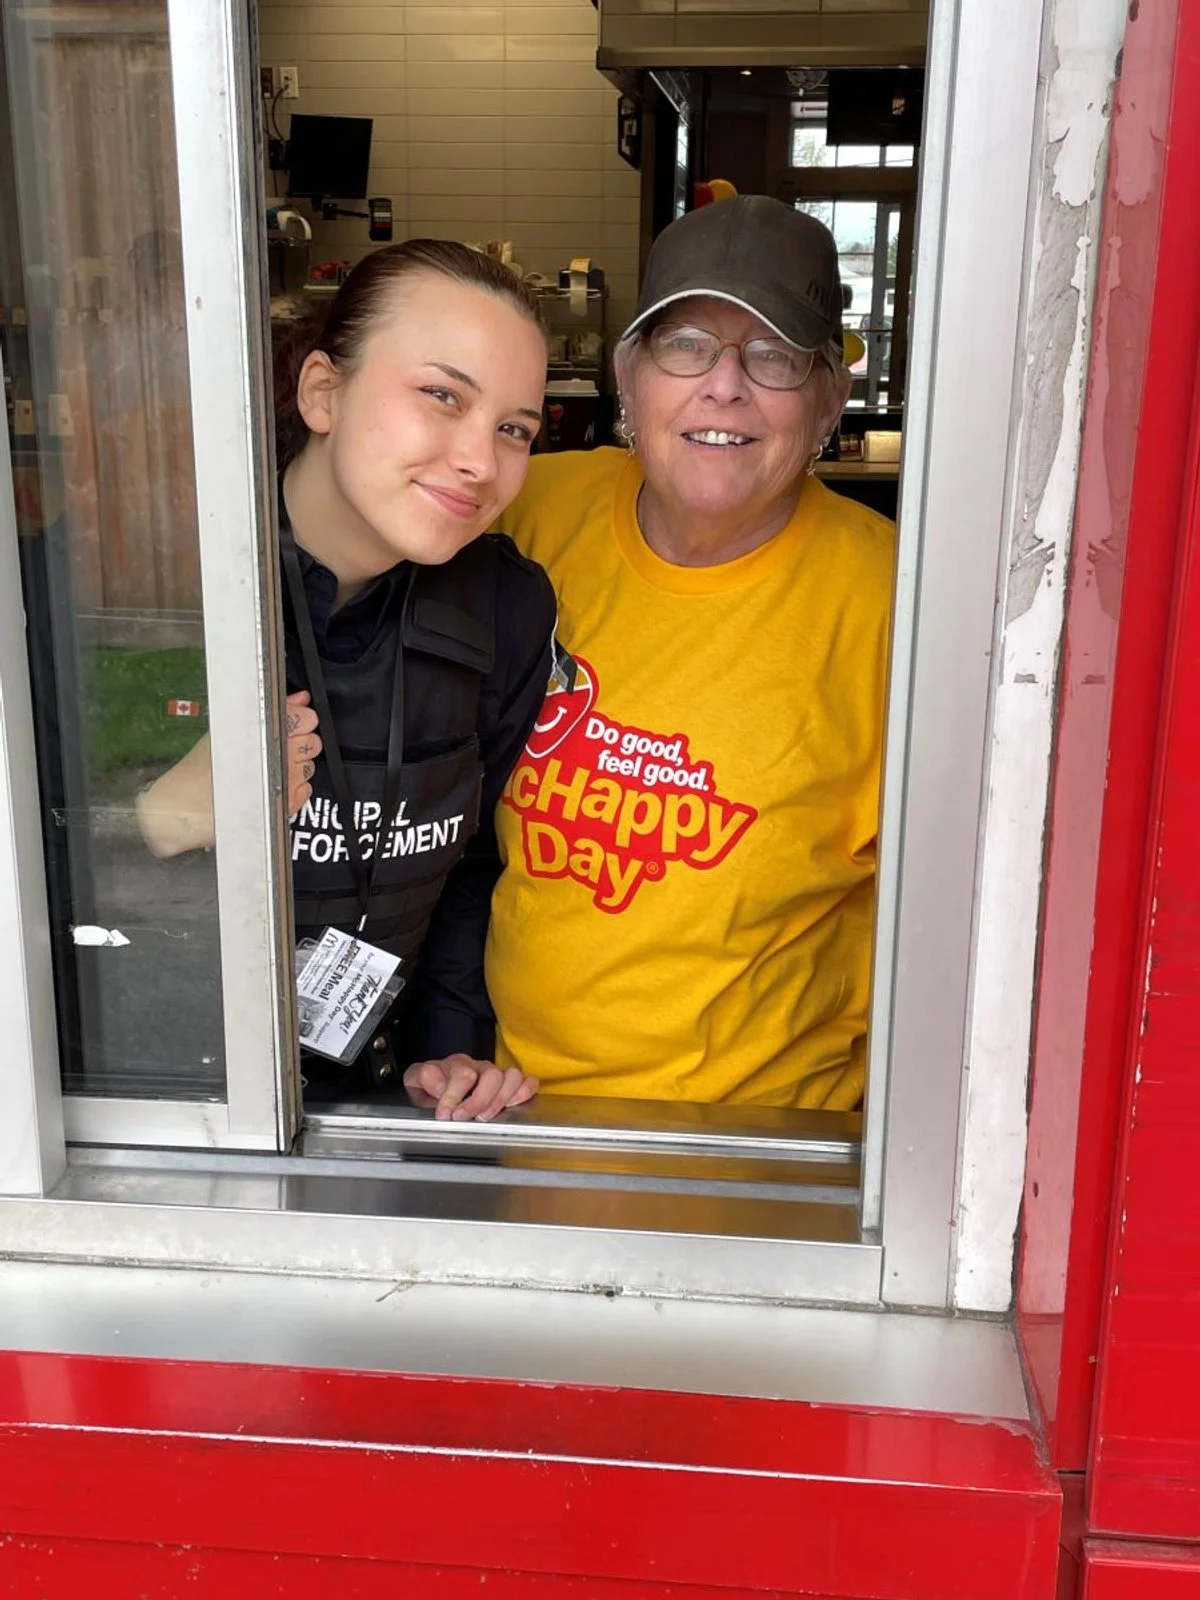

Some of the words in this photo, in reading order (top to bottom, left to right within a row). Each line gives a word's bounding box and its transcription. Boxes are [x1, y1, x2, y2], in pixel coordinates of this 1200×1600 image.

[585, 717, 619, 744] Do
[619, 732, 684, 766] good,
[597, 750, 643, 778] feel
[642, 763, 710, 792] good.
[505, 759, 750, 863] cHappy
[290, 814, 464, 863] FORCEMENT
[318, 971, 342, 1000] Meal
[349, 974, 382, 1008] Thank
